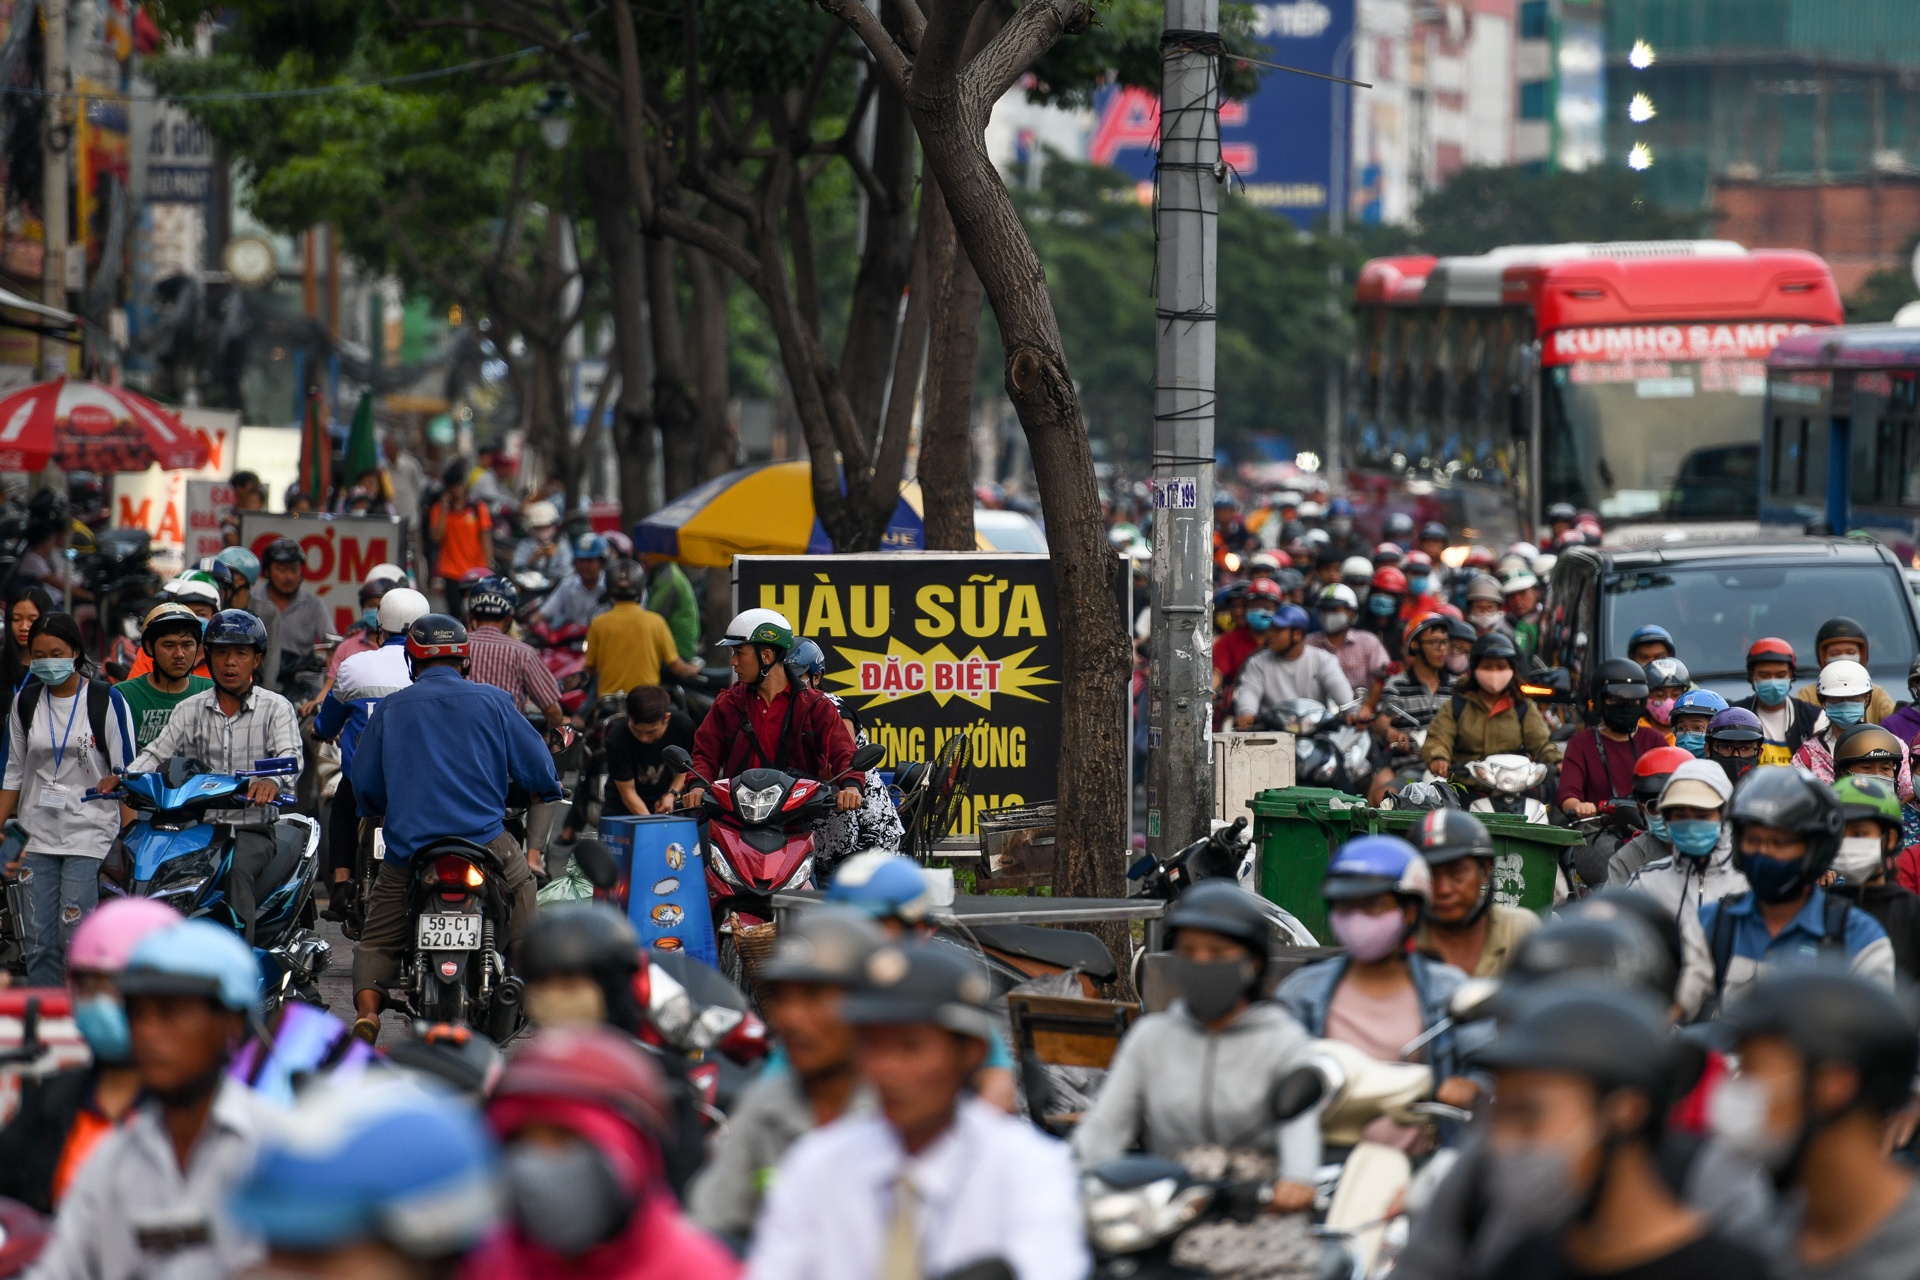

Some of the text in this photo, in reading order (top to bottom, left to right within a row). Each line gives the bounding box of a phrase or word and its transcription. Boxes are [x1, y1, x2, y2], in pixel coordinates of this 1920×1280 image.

[1555, 327, 1683, 352] KUMHO
[470, 594, 512, 611] QUALITY
[760, 573, 1047, 638] HÀU SỮA
[860, 656, 1002, 698] ĐẶC BIỆT
[865, 718, 926, 768] ỪNG
[429, 917, 470, 931] 59-C1
[421, 931, 476, 947] 520.43
